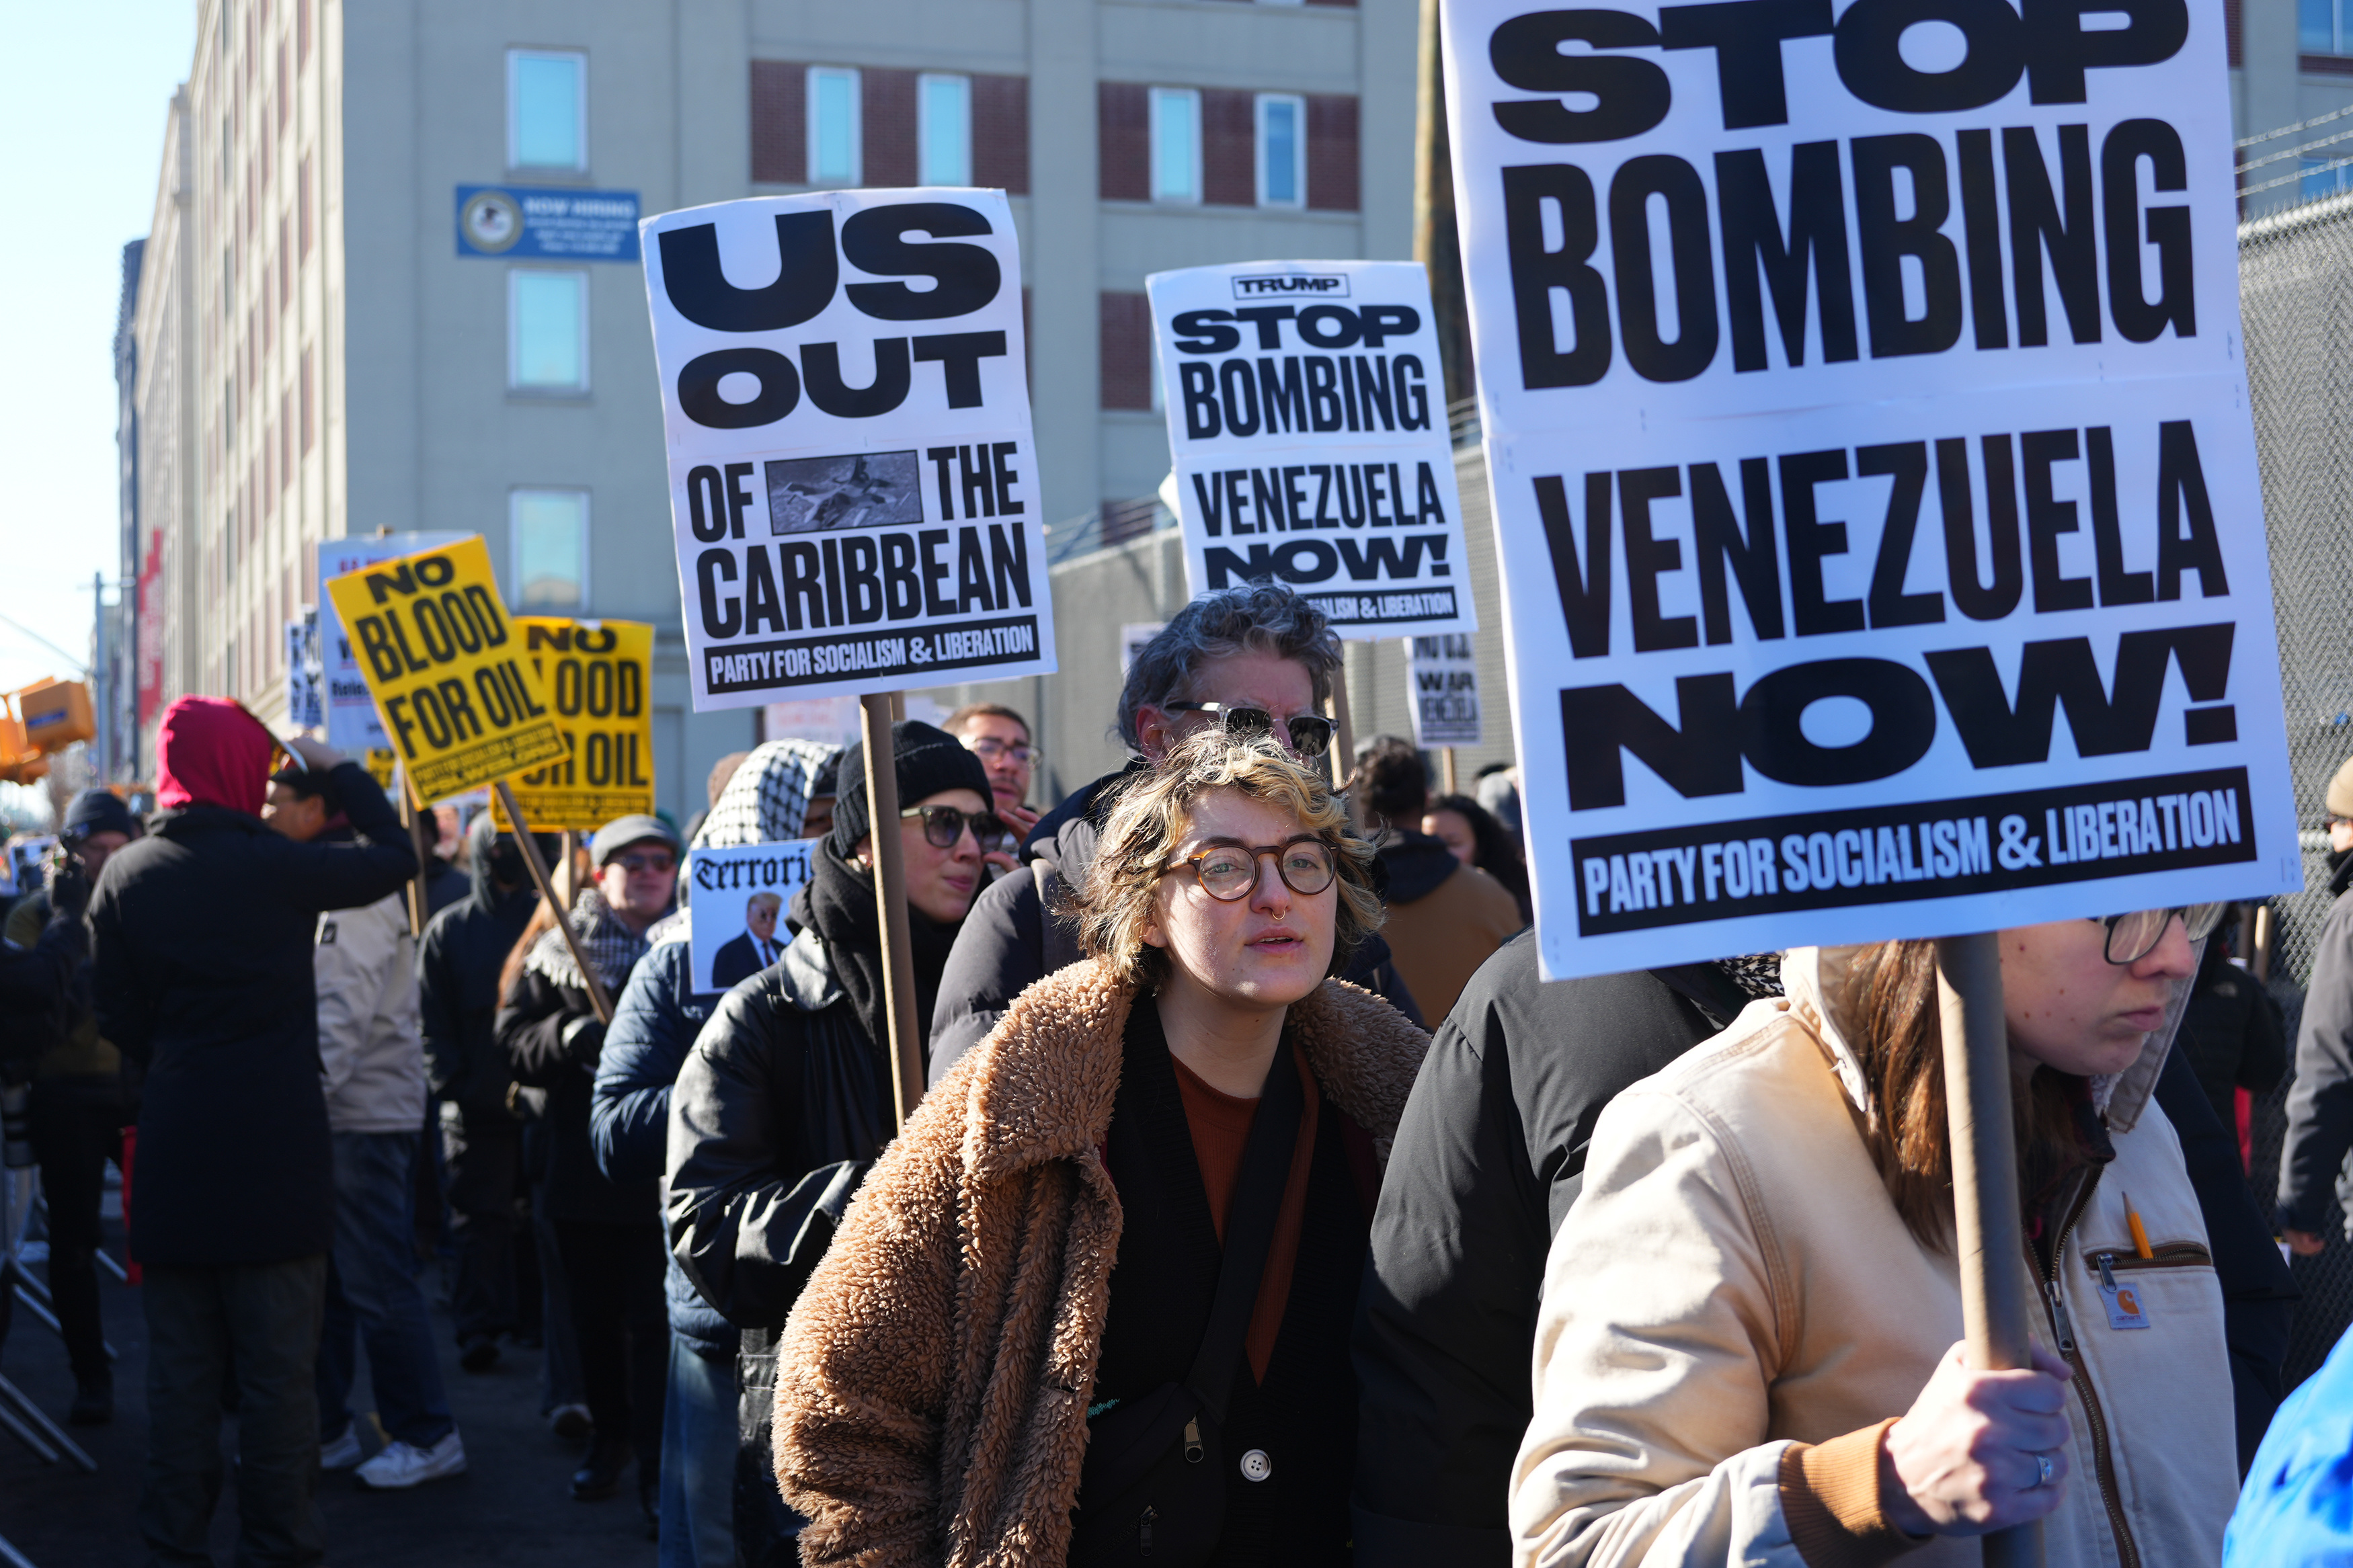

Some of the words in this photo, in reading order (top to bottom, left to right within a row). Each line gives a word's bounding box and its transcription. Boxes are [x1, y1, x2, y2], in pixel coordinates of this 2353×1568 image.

[1488, 0, 2190, 145] STOP
[658, 202, 1001, 332] US
[1237, 278, 1340, 293] TRUMP
[1501, 118, 2197, 391] BOMBING
[1171, 304, 1421, 354] STOP
[677, 330, 1006, 429] OUT
[1179, 354, 1431, 440] BOMBING
[687, 462, 754, 543] OF
[927, 442, 1024, 521] THE
[1191, 462, 1446, 538] VENEZUELA
[365, 556, 455, 604] NO
[1203, 534, 1451, 589] NOW!
[1531, 419, 2230, 660] VENEZUELA
[696, 522, 1032, 639] CARIBBEAN
[1359, 597, 1378, 619] &
[1378, 591, 1454, 618] LIBERATION
[354, 585, 508, 684] BLOOD
[528, 624, 617, 653] NO
[710, 651, 770, 685] PARTY
[773, 647, 812, 678] FOR
[813, 638, 906, 674] SOCIALISM
[909, 636, 934, 664] &
[934, 624, 1034, 661] LIBERATION
[384, 677, 483, 759] FOR
[474, 658, 547, 729] OIL
[532, 659, 642, 718] OOD
[1417, 671, 1475, 691] WAR
[1559, 621, 2238, 811] NOW!
[586, 732, 649, 786] OIL
[694, 847, 815, 891] Terrori
[1582, 845, 1696, 916] PARTY
[1701, 837, 1779, 901] FOR
[1780, 816, 1991, 893] SOCIALISM
[1997, 814, 2044, 870] &
[2045, 788, 2241, 865] LIBERATION
